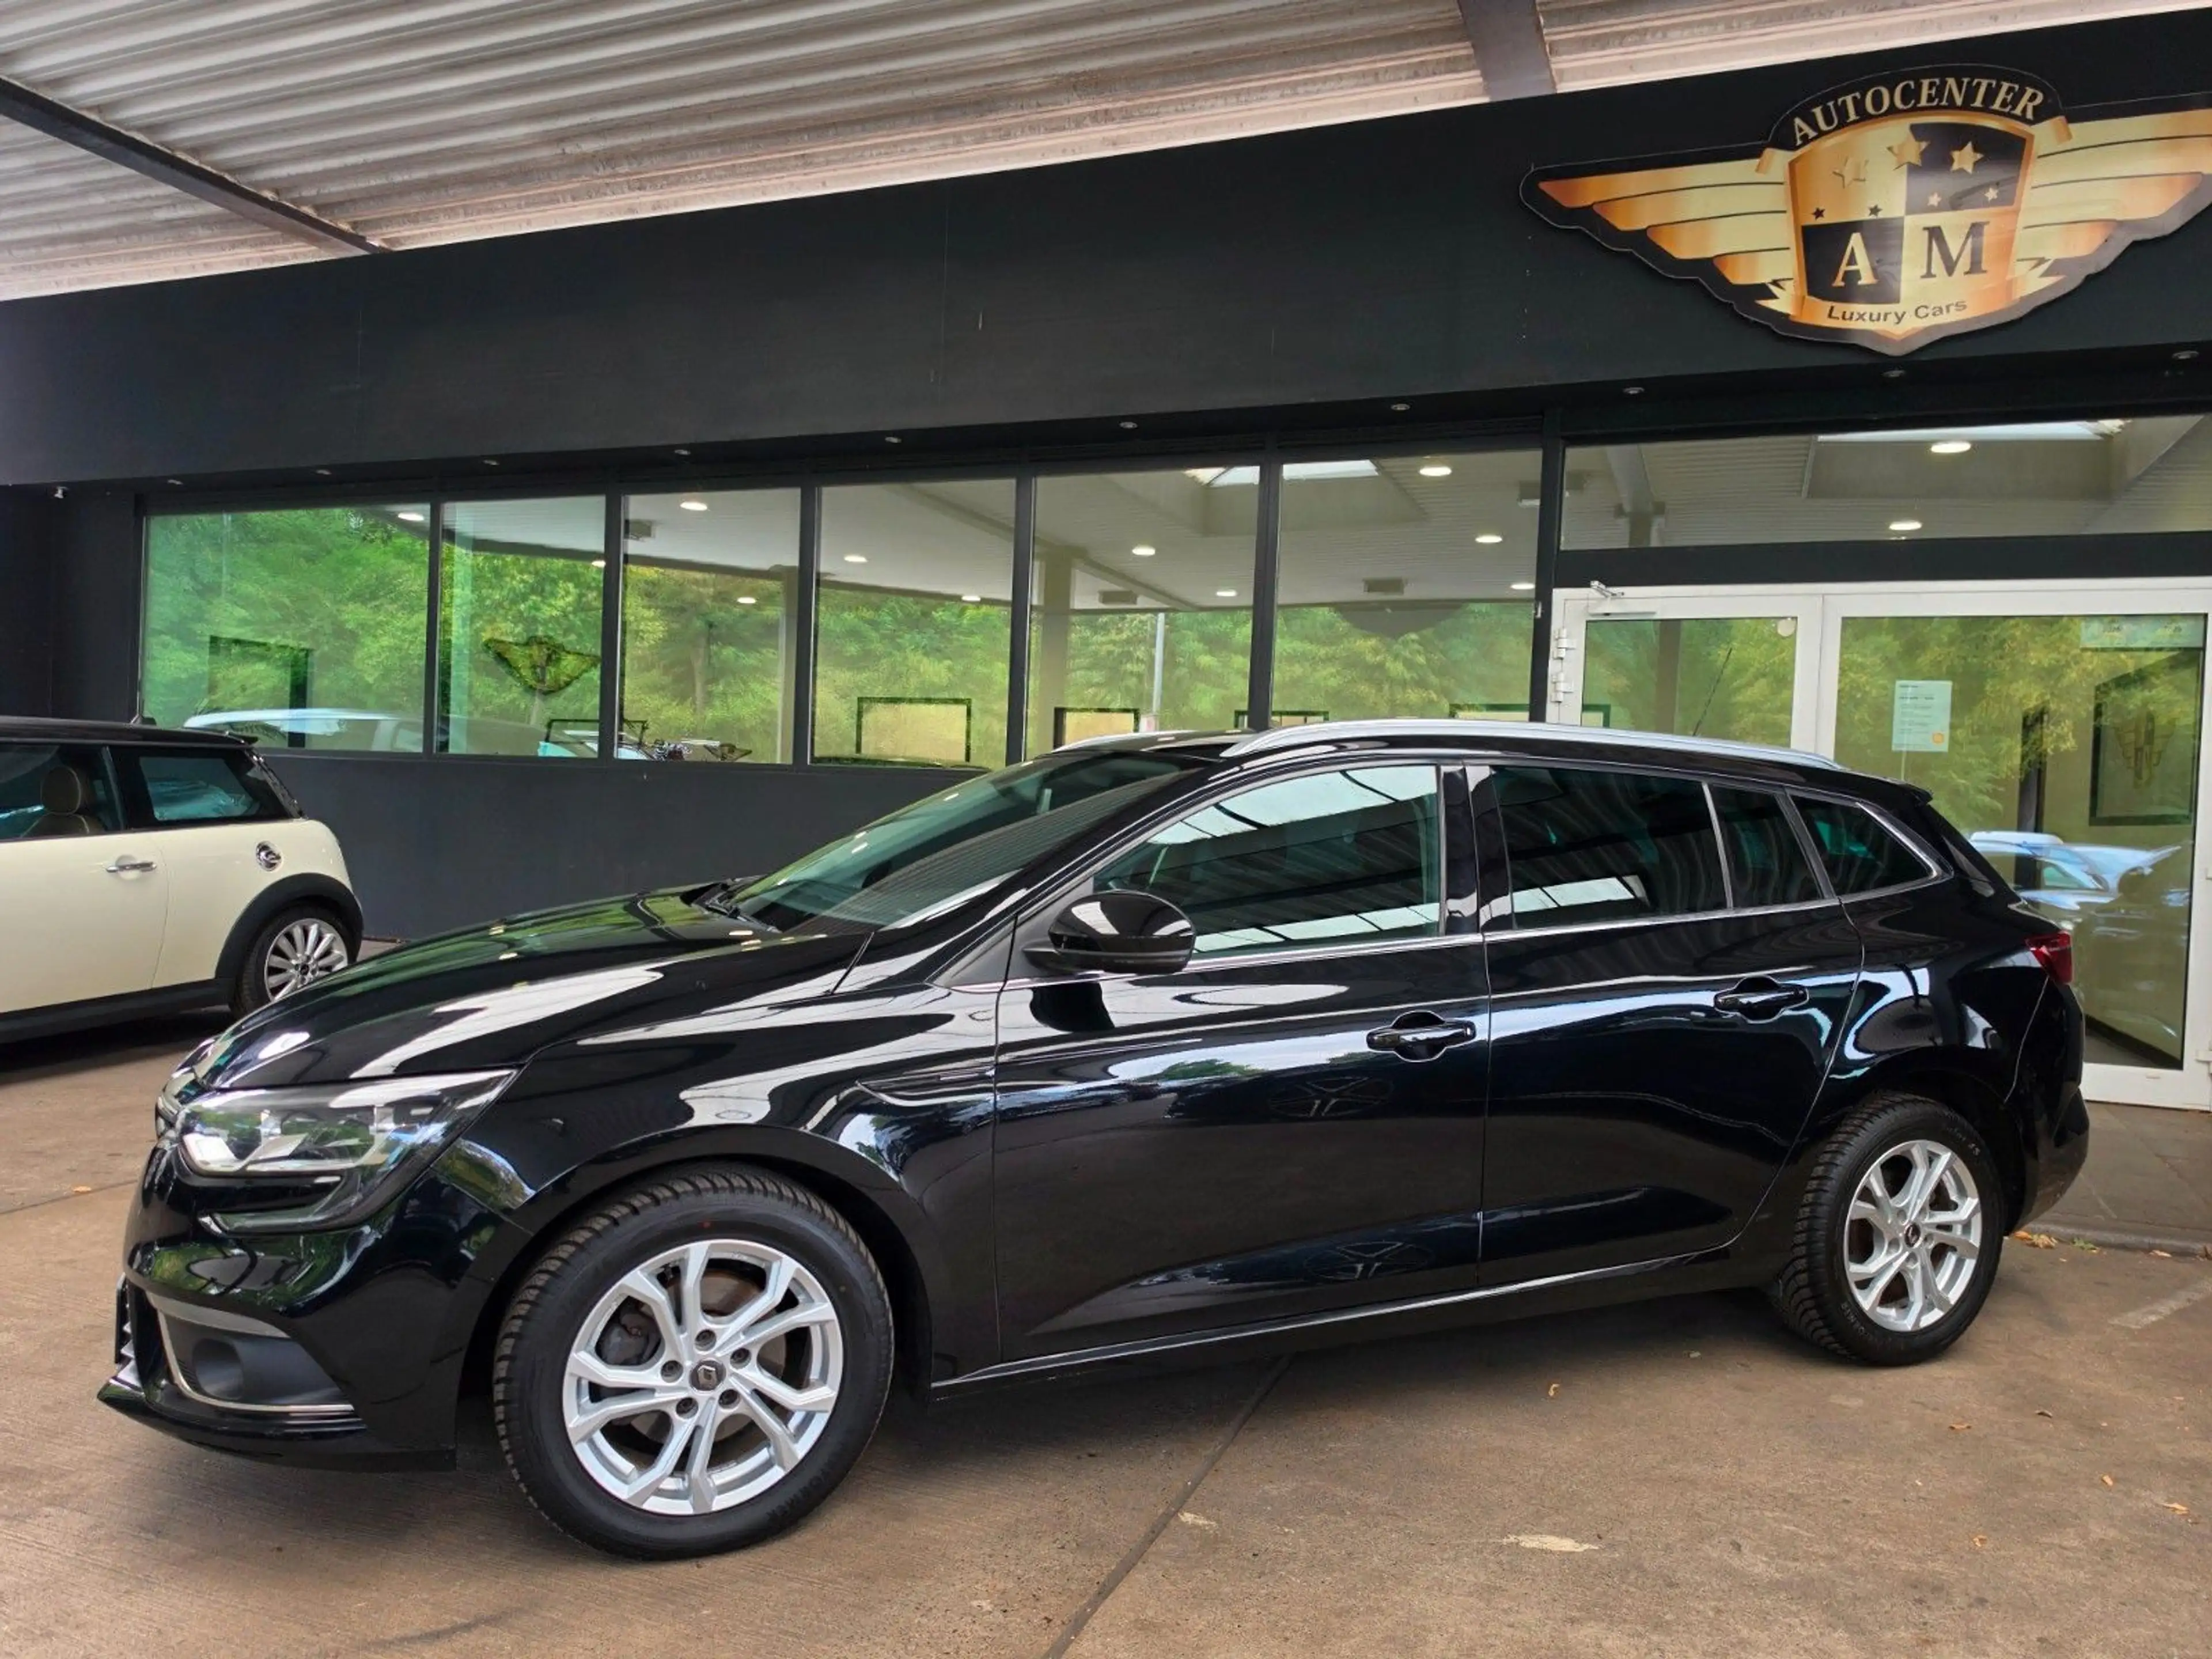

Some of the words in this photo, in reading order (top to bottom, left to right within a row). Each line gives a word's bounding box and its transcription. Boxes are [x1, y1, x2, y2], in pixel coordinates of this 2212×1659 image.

[1793, 77, 2044, 146] AUTOCENTER
[1831, 232, 1879, 287] A
[1920, 221, 1990, 279] M
[1827, 305, 1907, 324] Luxury
[1914, 300, 1968, 319] Cars
